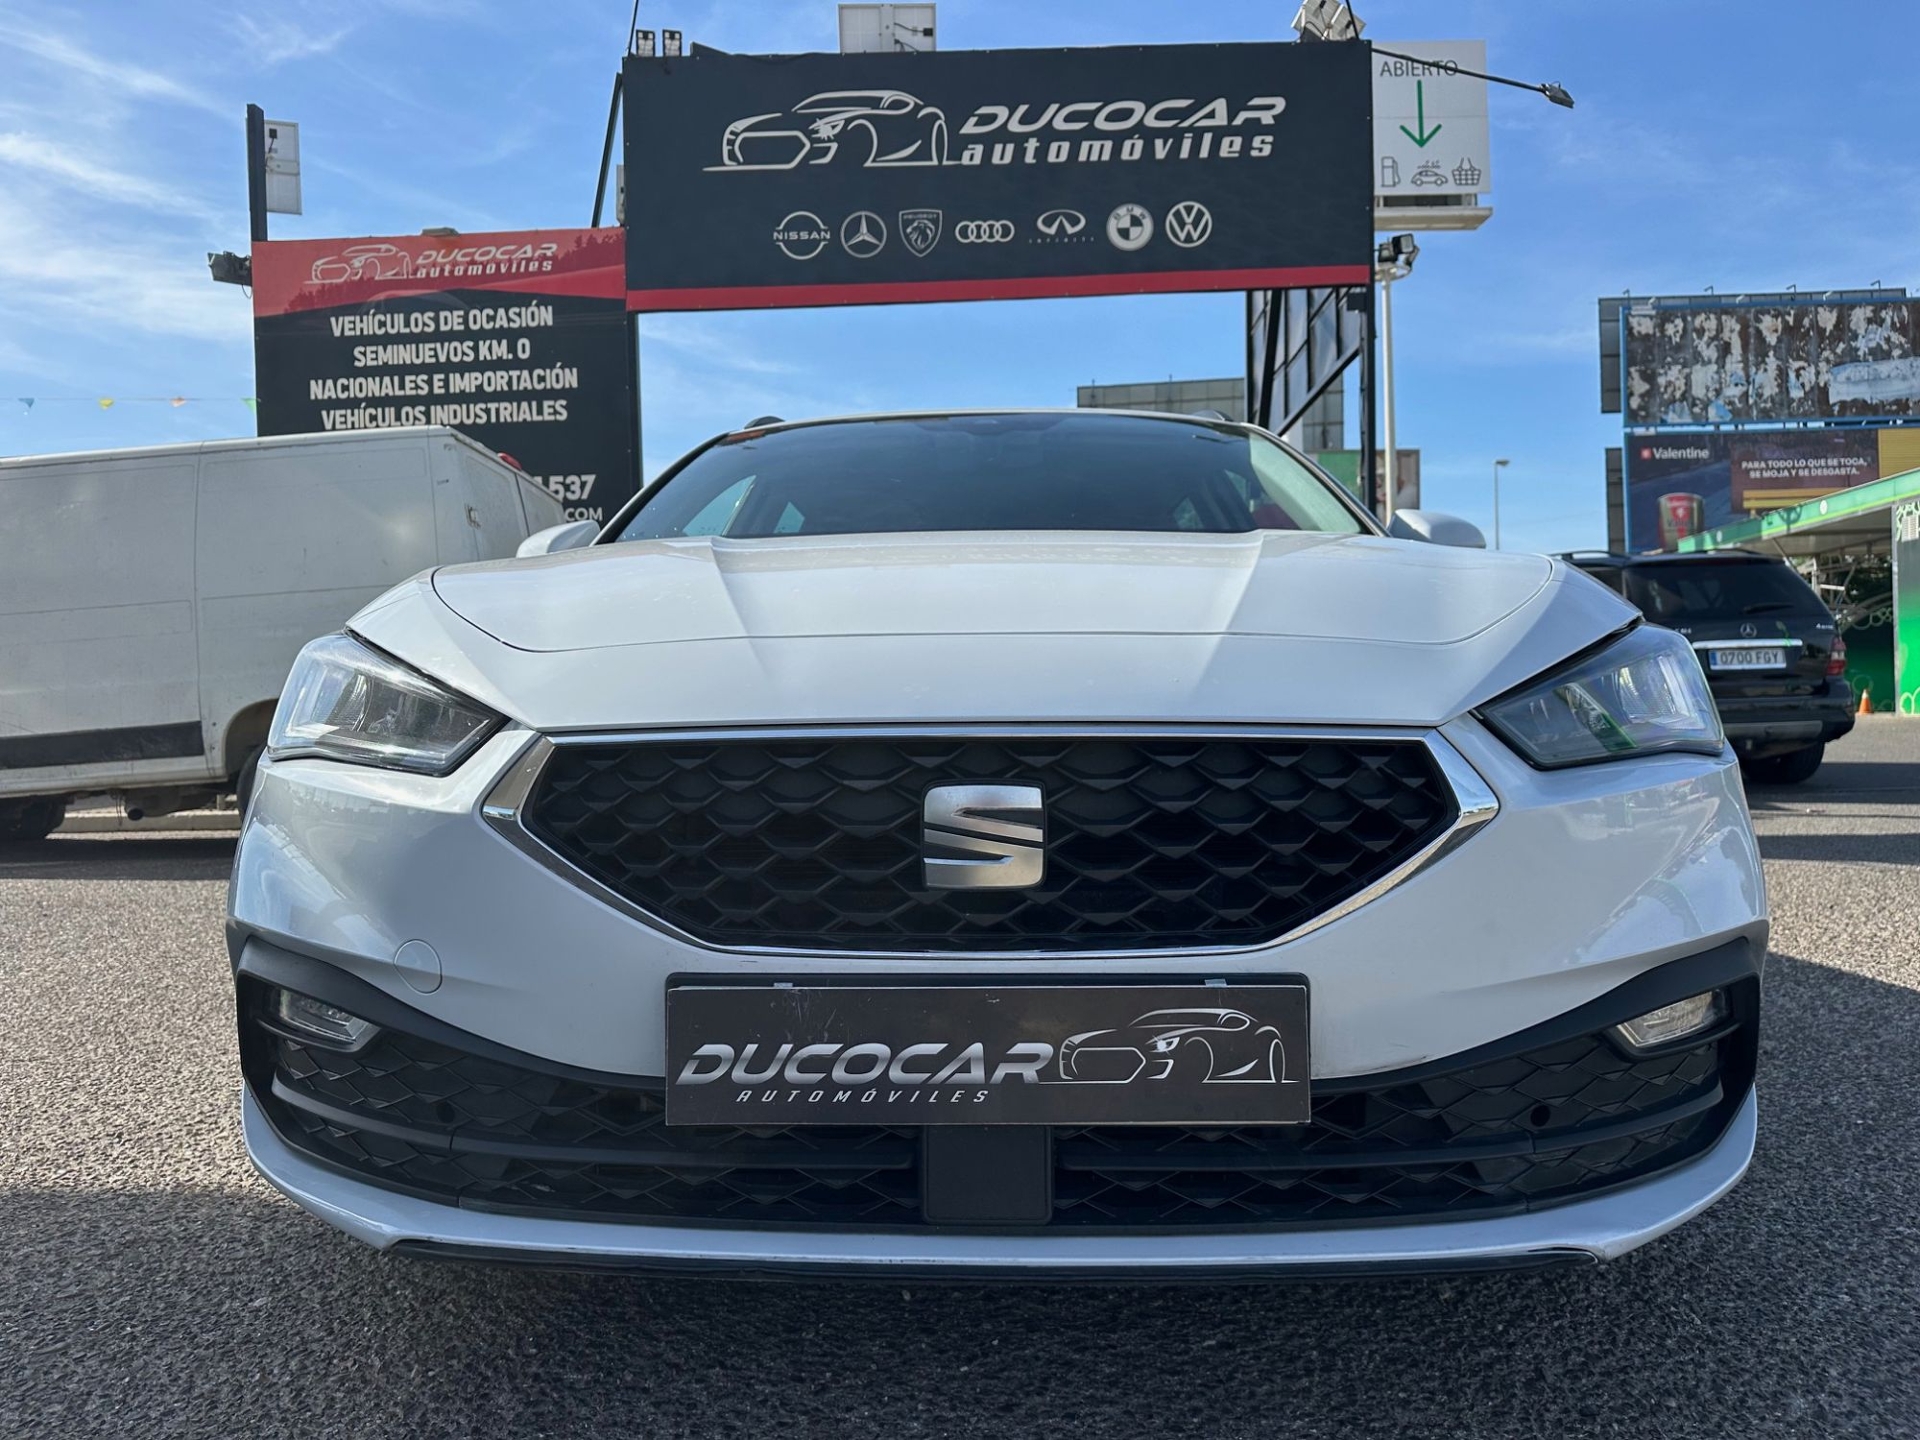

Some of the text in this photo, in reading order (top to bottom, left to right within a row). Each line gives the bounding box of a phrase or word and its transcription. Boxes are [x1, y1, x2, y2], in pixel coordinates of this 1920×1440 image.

[1380, 60, 1458, 77] ABIERTO
[959, 97, 1286, 134] DUCOCAR
[961, 132, 1274, 165] automóviles
[773, 230, 831, 241] NISSAN
[416, 243, 558, 264] DUCOCAR
[330, 301, 553, 337] VEHÍCULOS DE OCASIÓN
[353, 341, 474, 367] SEMINUEVOS
[478, 339, 513, 361] KM.
[310, 363, 578, 400] NACIONALES E IMPORTACIÓN
[321, 400, 568, 430] VEHÍCULOS INDUSTRIALES
[1653, 446, 1710, 459] Valentine
[1741, 461, 1766, 469] PARA
[1768, 460, 1793, 468] TODO
[1794, 459, 1806, 467] LO
[1807, 459, 1826, 468] QUE
[1749, 470, 1761, 478] SE
[1762, 469, 1789, 477] MOJA
[1811, 467, 1860, 475] DESGASTA.
[1720, 650, 1779, 664] 0700 FGY
[676, 1042, 1054, 1085] DUCOCAR
[735, 1088, 988, 1103] AUTOMÓVILES
